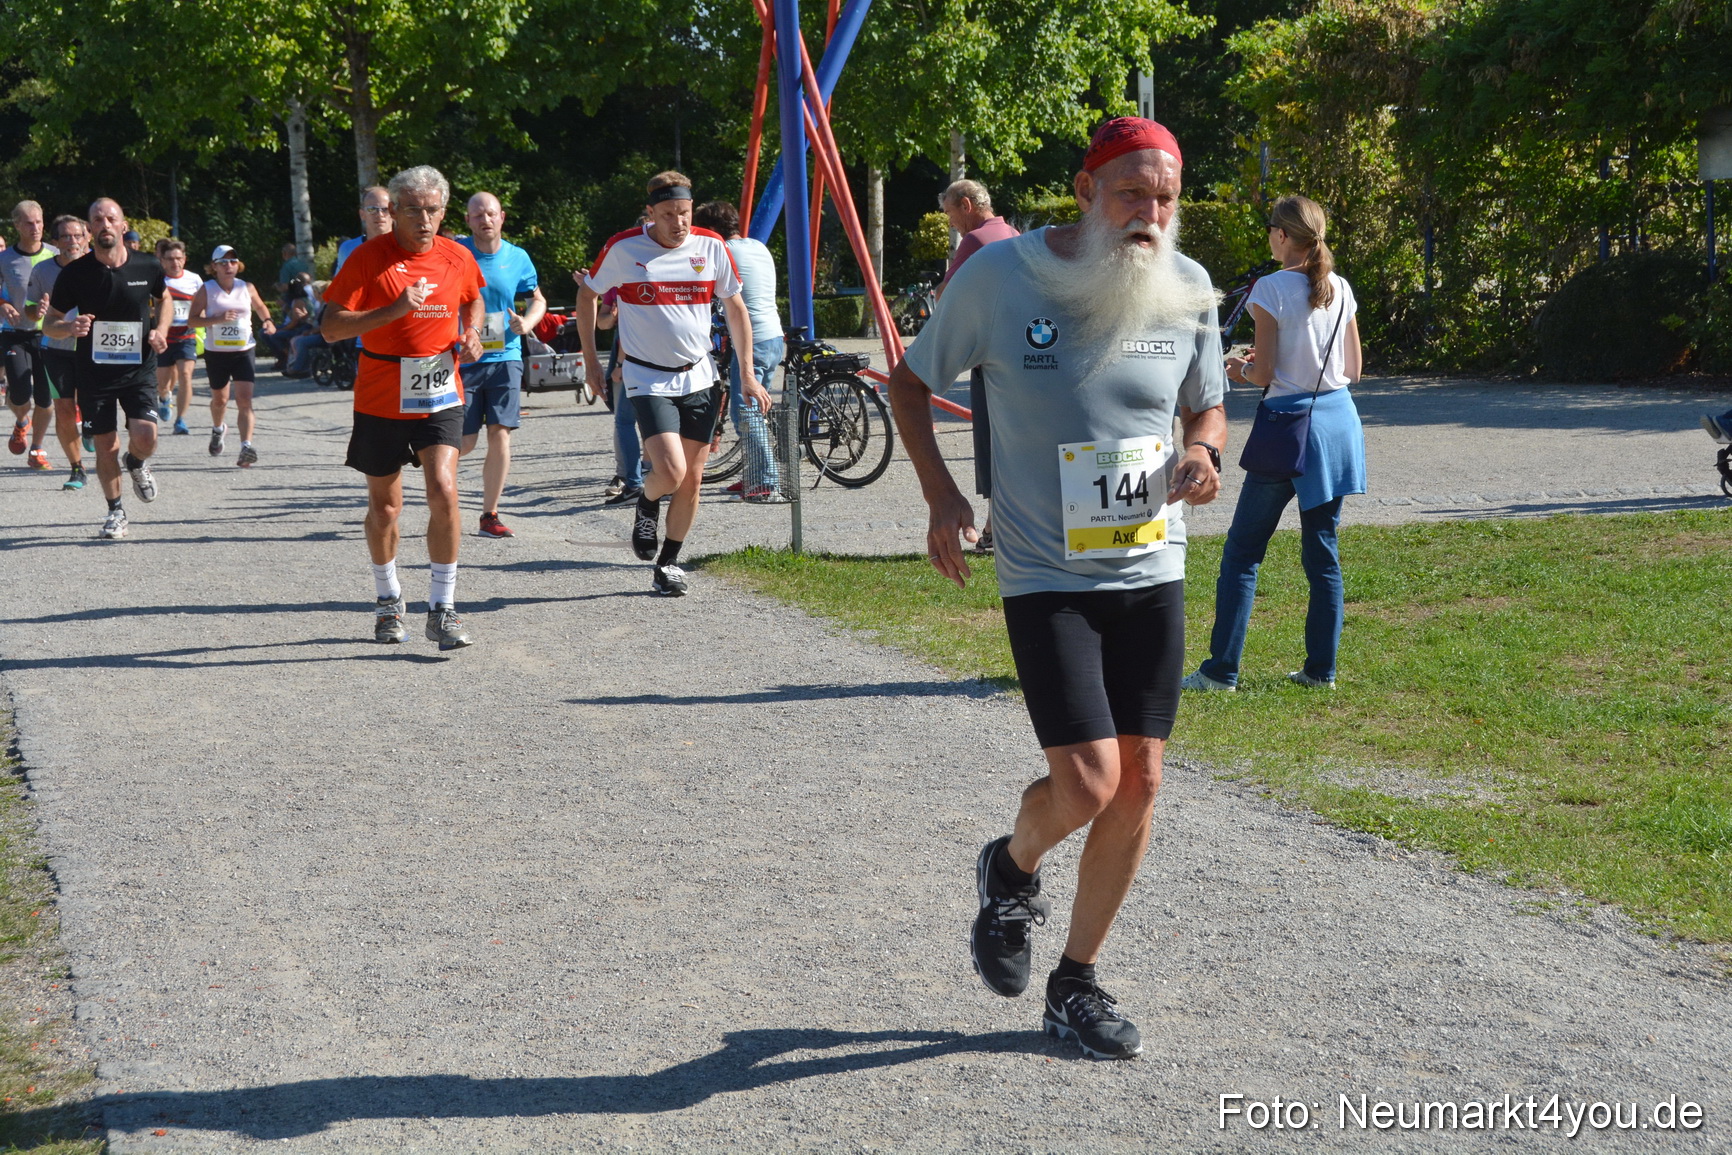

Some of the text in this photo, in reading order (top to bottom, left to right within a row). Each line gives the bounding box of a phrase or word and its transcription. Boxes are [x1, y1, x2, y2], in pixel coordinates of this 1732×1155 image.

[658, 285, 708, 293] Mercedes-Benz
[1028, 318, 1057, 330] BMW
[221, 326, 239, 336] 226
[101, 333, 135, 347] 2354
[1120, 340, 1176, 355] BOCK
[1023, 354, 1059, 363] PARTL
[410, 368, 450, 391] 2192
[417, 396, 445, 408] Michael
[1097, 449, 1144, 464] BOCK
[1093, 471, 1149, 509] 144
[1090, 511, 1147, 523] PARTL Neumarkt
[1112, 527, 1140, 545] Axel
